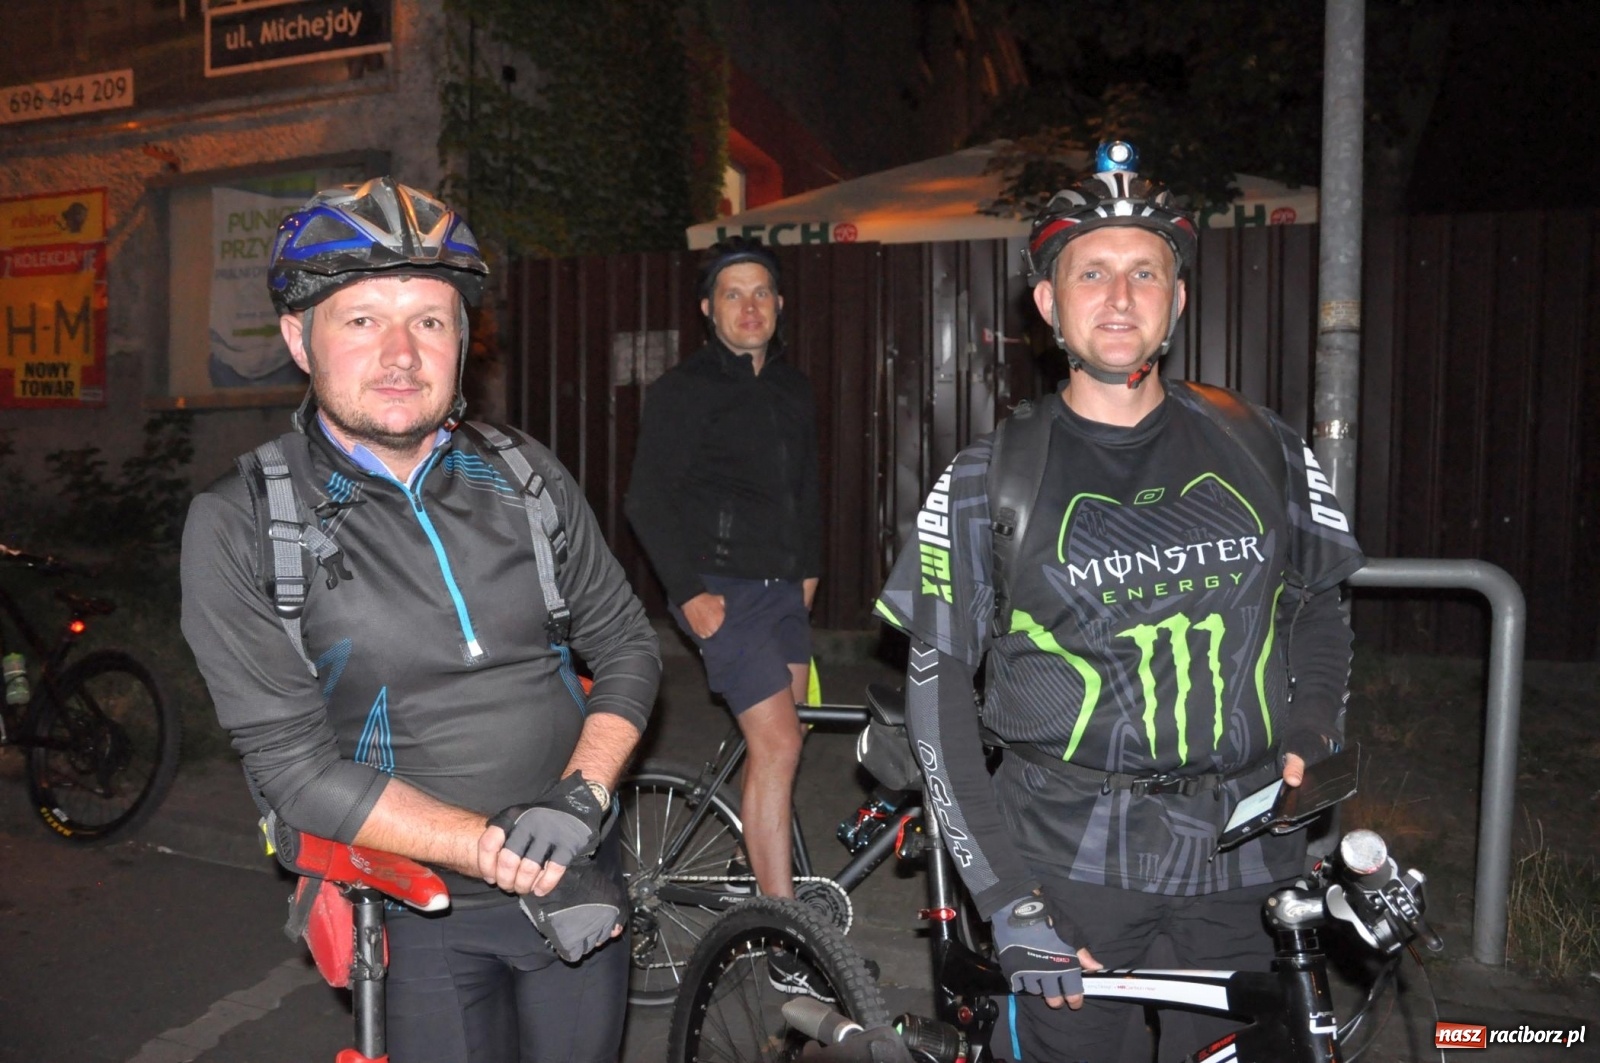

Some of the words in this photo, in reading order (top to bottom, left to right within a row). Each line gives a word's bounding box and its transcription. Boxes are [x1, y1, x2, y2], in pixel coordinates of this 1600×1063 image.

[226, 25, 252, 49] ul.
[260, 7, 362, 44] Michejdy
[9, 91, 43, 113] 696
[49, 84, 85, 108] 464
[92, 77, 126, 102] 209
[228, 205, 299, 233] PUNK
[25, 362, 70, 378] NOWY
[20, 380, 75, 397] TOWAR
[1102, 572, 1243, 604] ENERGY
